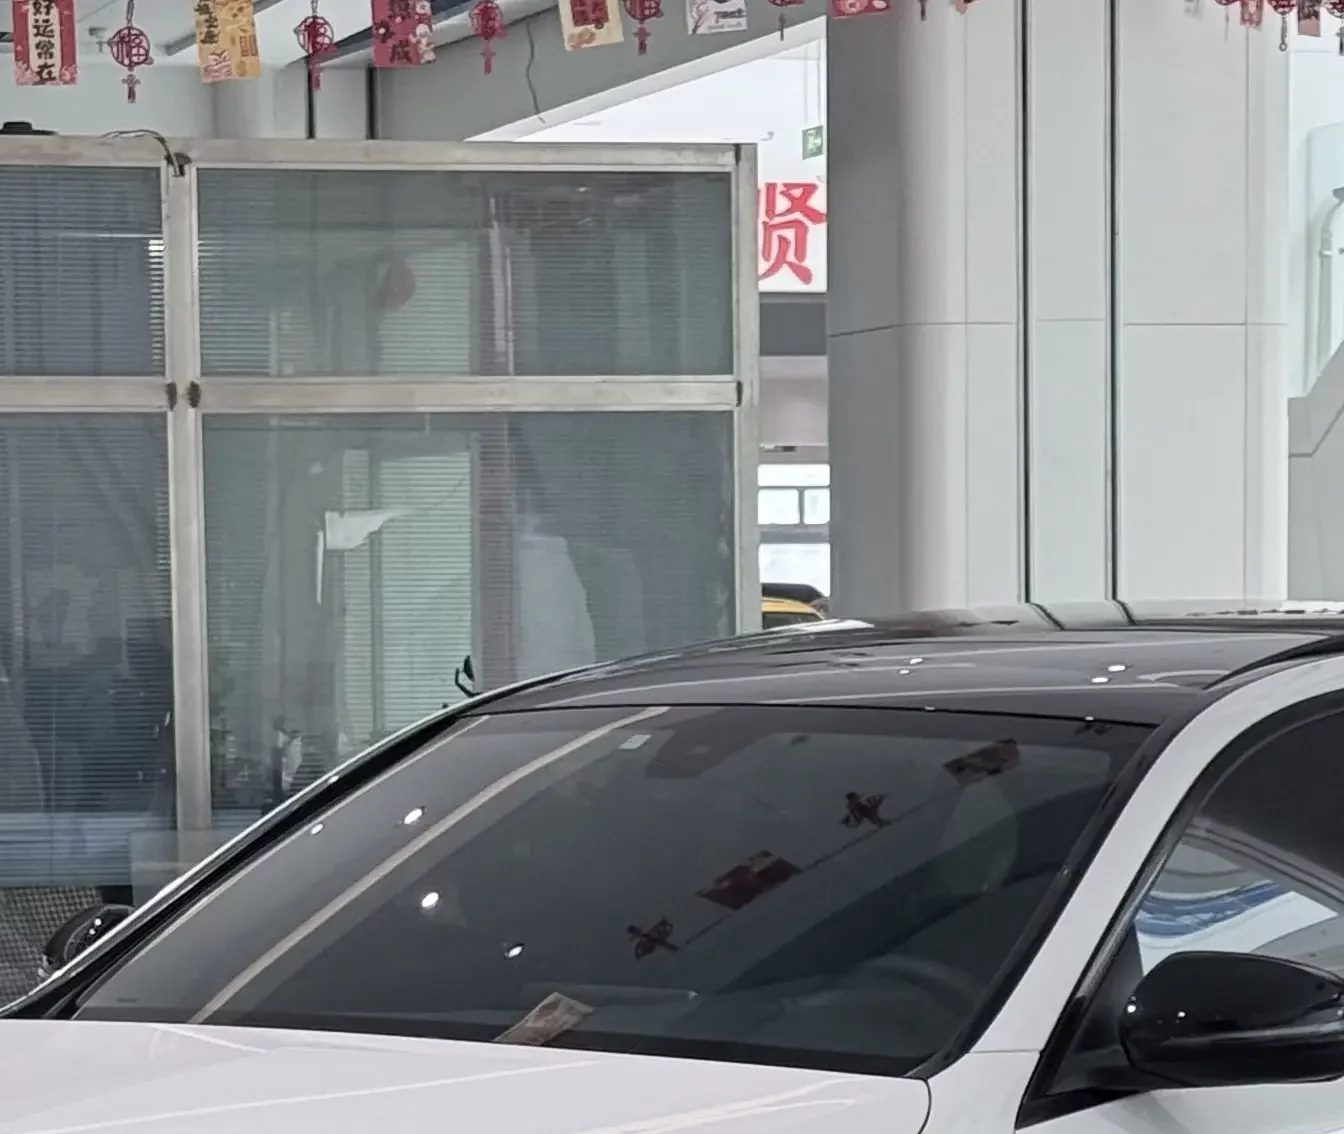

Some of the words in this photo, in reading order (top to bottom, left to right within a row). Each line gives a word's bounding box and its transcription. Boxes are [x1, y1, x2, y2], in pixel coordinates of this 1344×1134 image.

[32, 0, 56, 81] 好运常在
[757, 182, 826, 285] 贤
